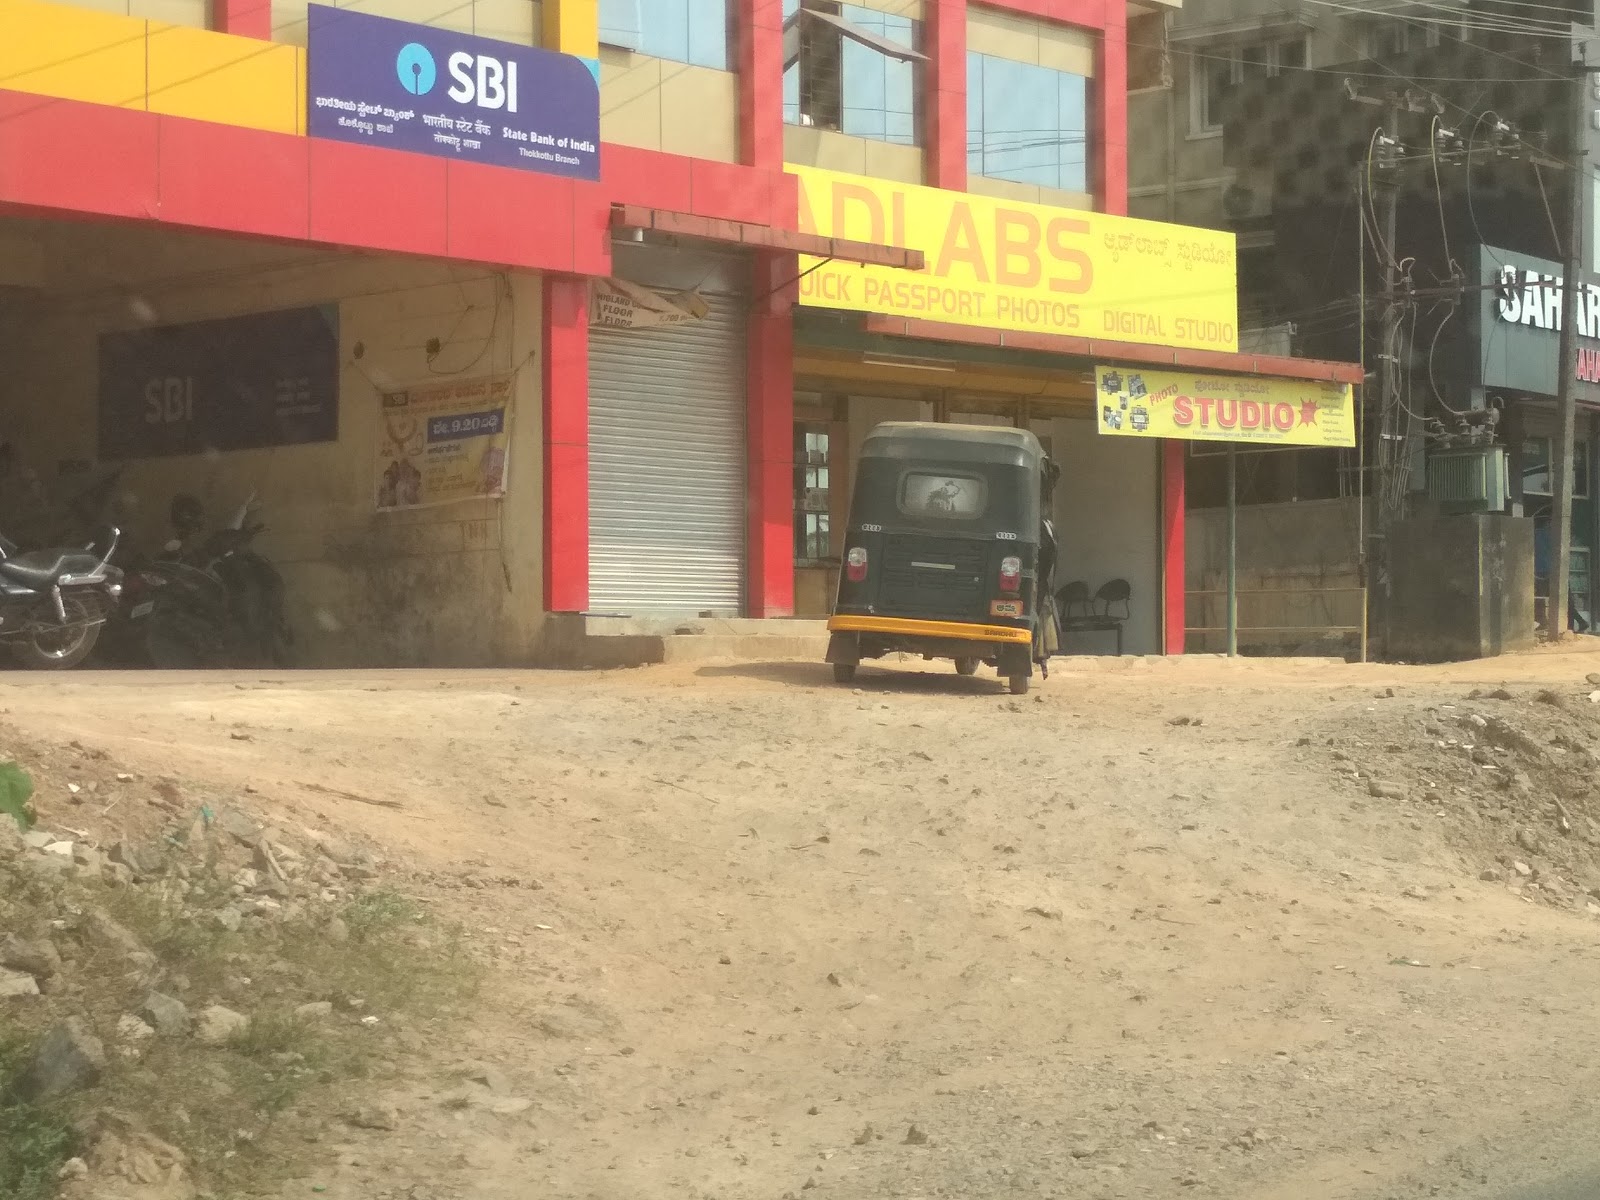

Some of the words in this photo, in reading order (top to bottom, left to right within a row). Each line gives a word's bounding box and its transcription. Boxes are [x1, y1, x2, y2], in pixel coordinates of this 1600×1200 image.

[448, 52, 517, 113] SBI
[422, 114, 453, 129] भारतीय
[455, 116, 473, 133] स्टेट
[474, 119, 491, 135] बैंक
[503, 126, 528, 141] State
[530, 131, 555, 146] Bank
[557, 137, 568, 148] of
[570, 138, 595, 153] India
[555, 153, 580, 165] Branch
[864, 278, 985, 318] PASSPORT
[997, 295, 1080, 328] PHOTOS
[1103, 310, 1166, 337] DIGITAL
[1175, 318, 1233, 343] STUDIO
[1150, 383, 1179, 406] PHOTO
[1173, 395, 1295, 430] STUDIO
